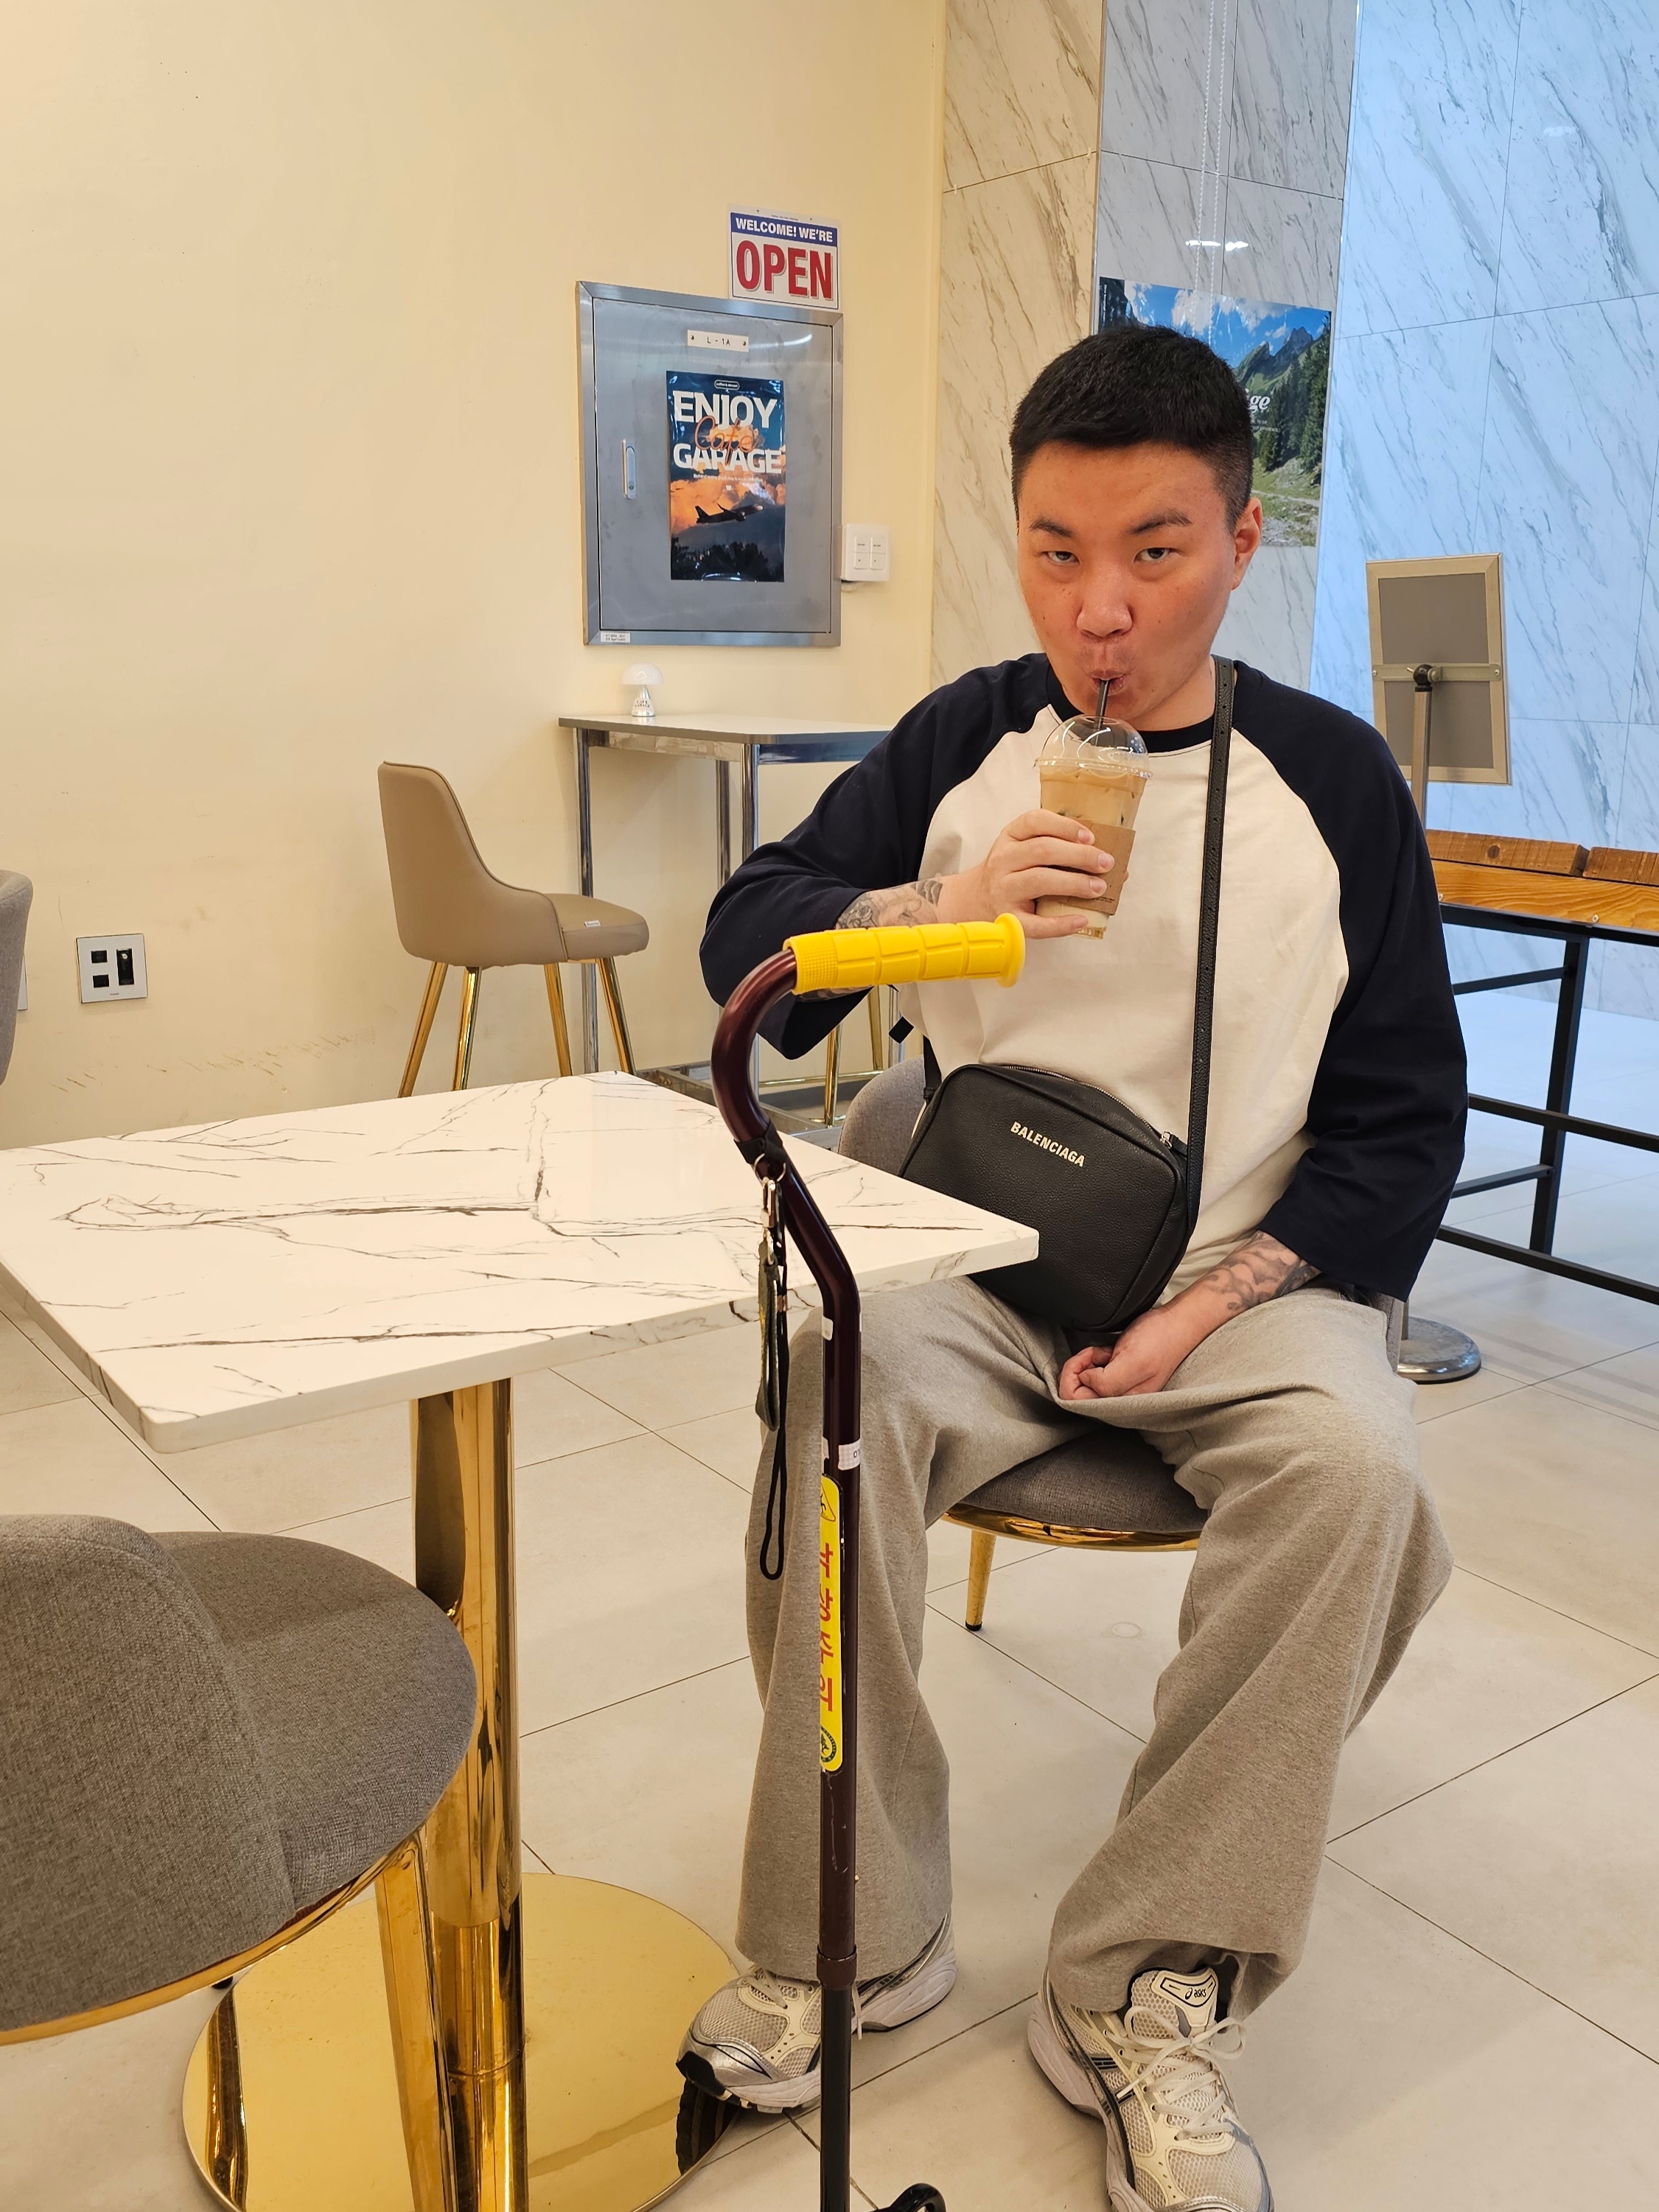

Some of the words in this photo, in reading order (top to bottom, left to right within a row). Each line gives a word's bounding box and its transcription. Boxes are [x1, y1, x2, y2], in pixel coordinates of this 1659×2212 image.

[736, 217, 797, 237] WELCOME!
[799, 227, 834, 242] WE'RE
[736, 239, 833, 301] OPEN
[672, 391, 778, 430] ENJOY
[673, 443, 782, 474] GARAGE
[1010, 1121, 1085, 1167] BALENCIAGA
